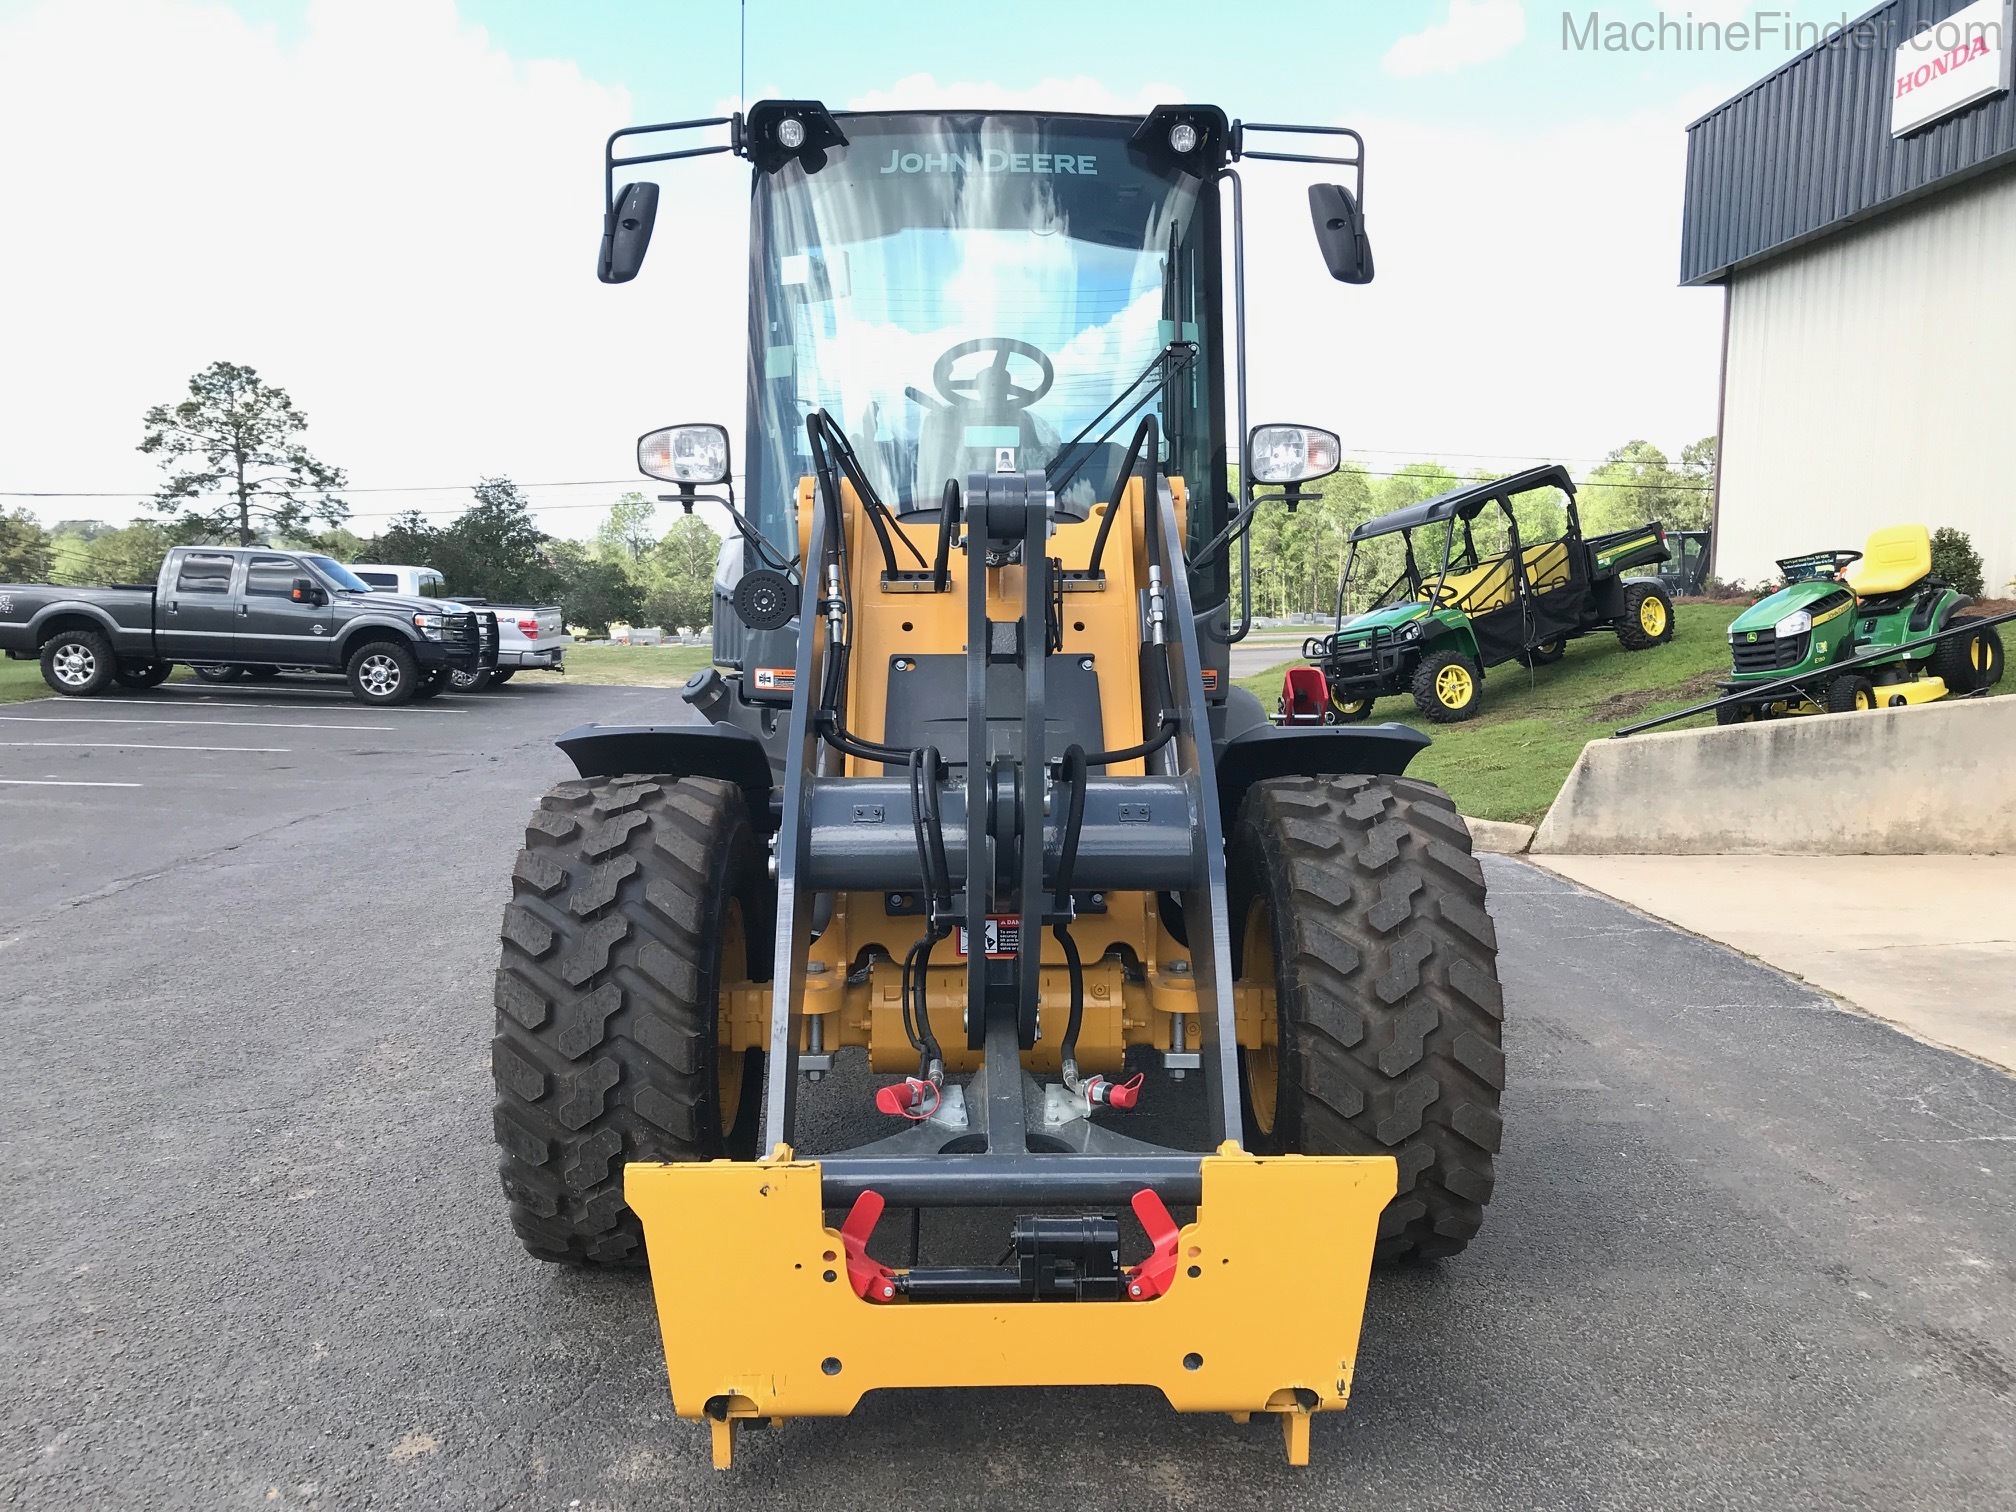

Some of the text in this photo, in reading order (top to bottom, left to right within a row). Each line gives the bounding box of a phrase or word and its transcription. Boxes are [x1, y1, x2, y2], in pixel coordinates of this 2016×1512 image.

[1895, 35, 1990, 99] HONDA
[880, 149, 1098, 176] JOHN DEERE
